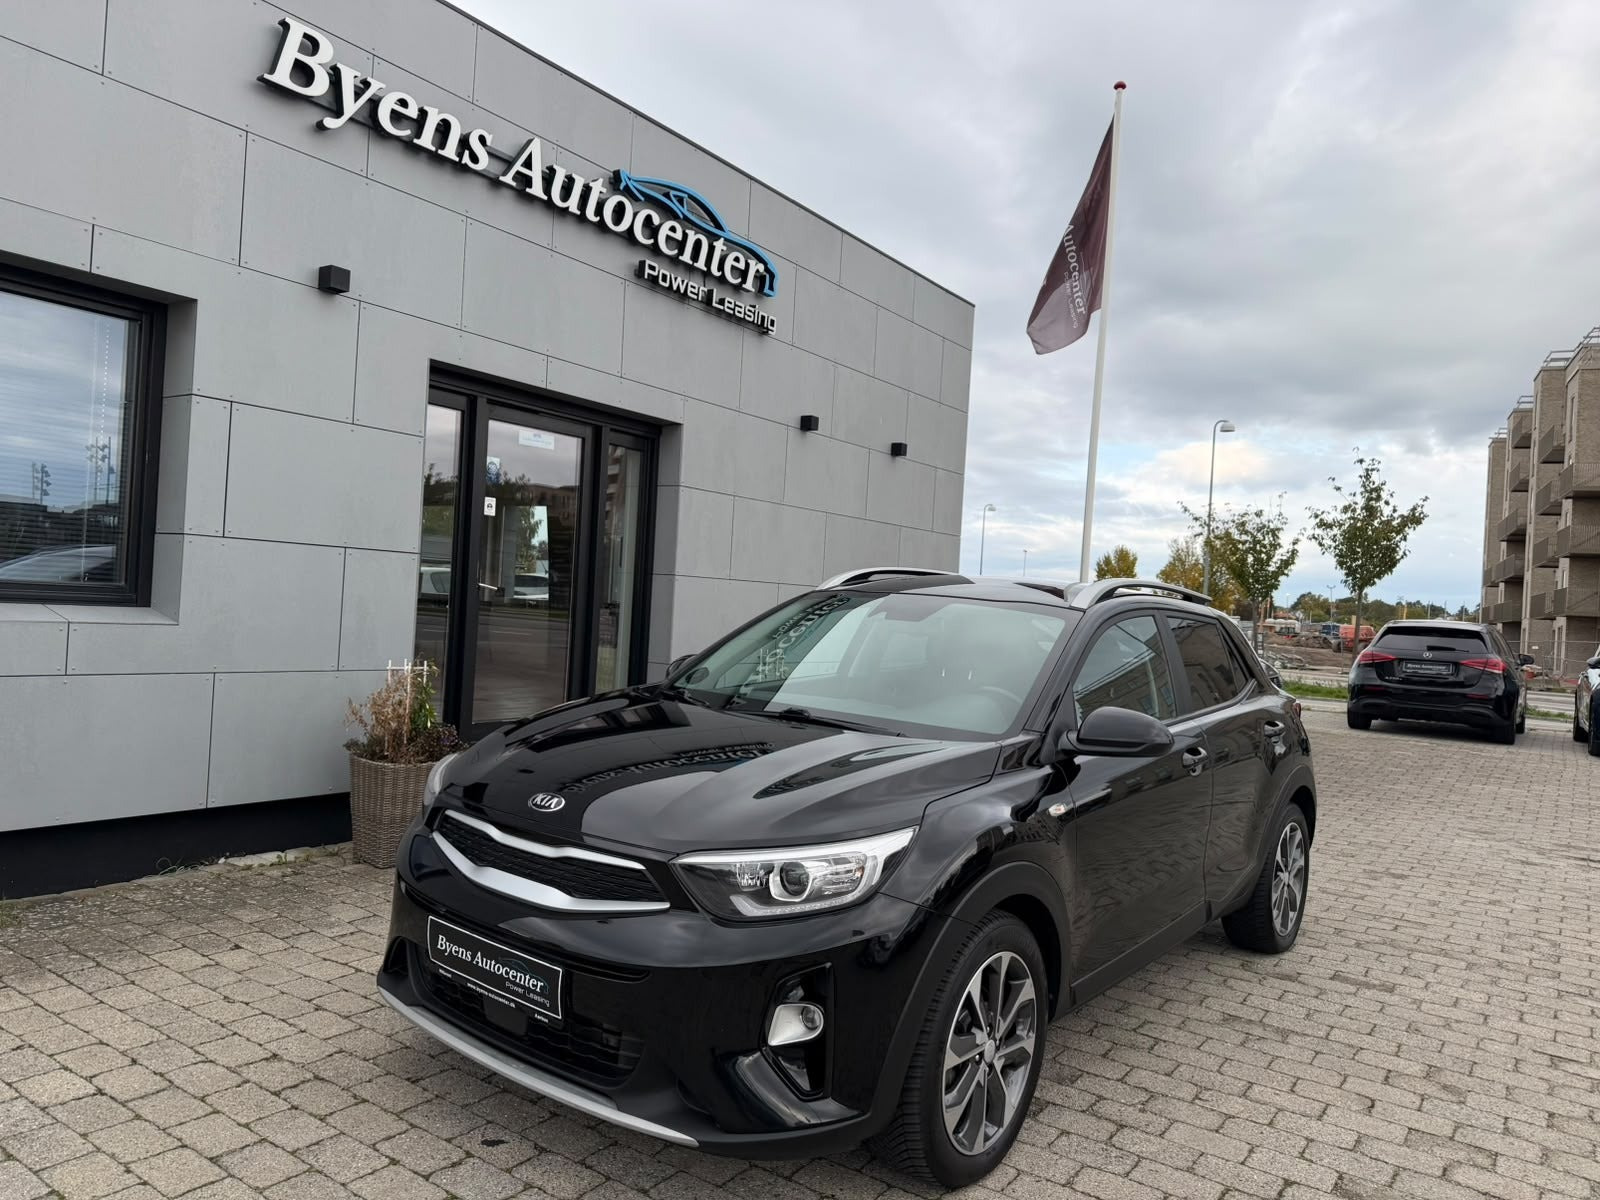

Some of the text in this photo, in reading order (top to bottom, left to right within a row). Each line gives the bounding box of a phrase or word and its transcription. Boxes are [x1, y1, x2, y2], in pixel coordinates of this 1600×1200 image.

[261, 16, 767, 293] Byens Autocenter
[644, 259, 777, 336] Power Leasing
[1063, 224, 1086, 315] Autocenter
[532, 793, 560, 809] KIA
[437, 934, 544, 993] Byens Autocenter
[505, 981, 550, 1008] Power Leasing
